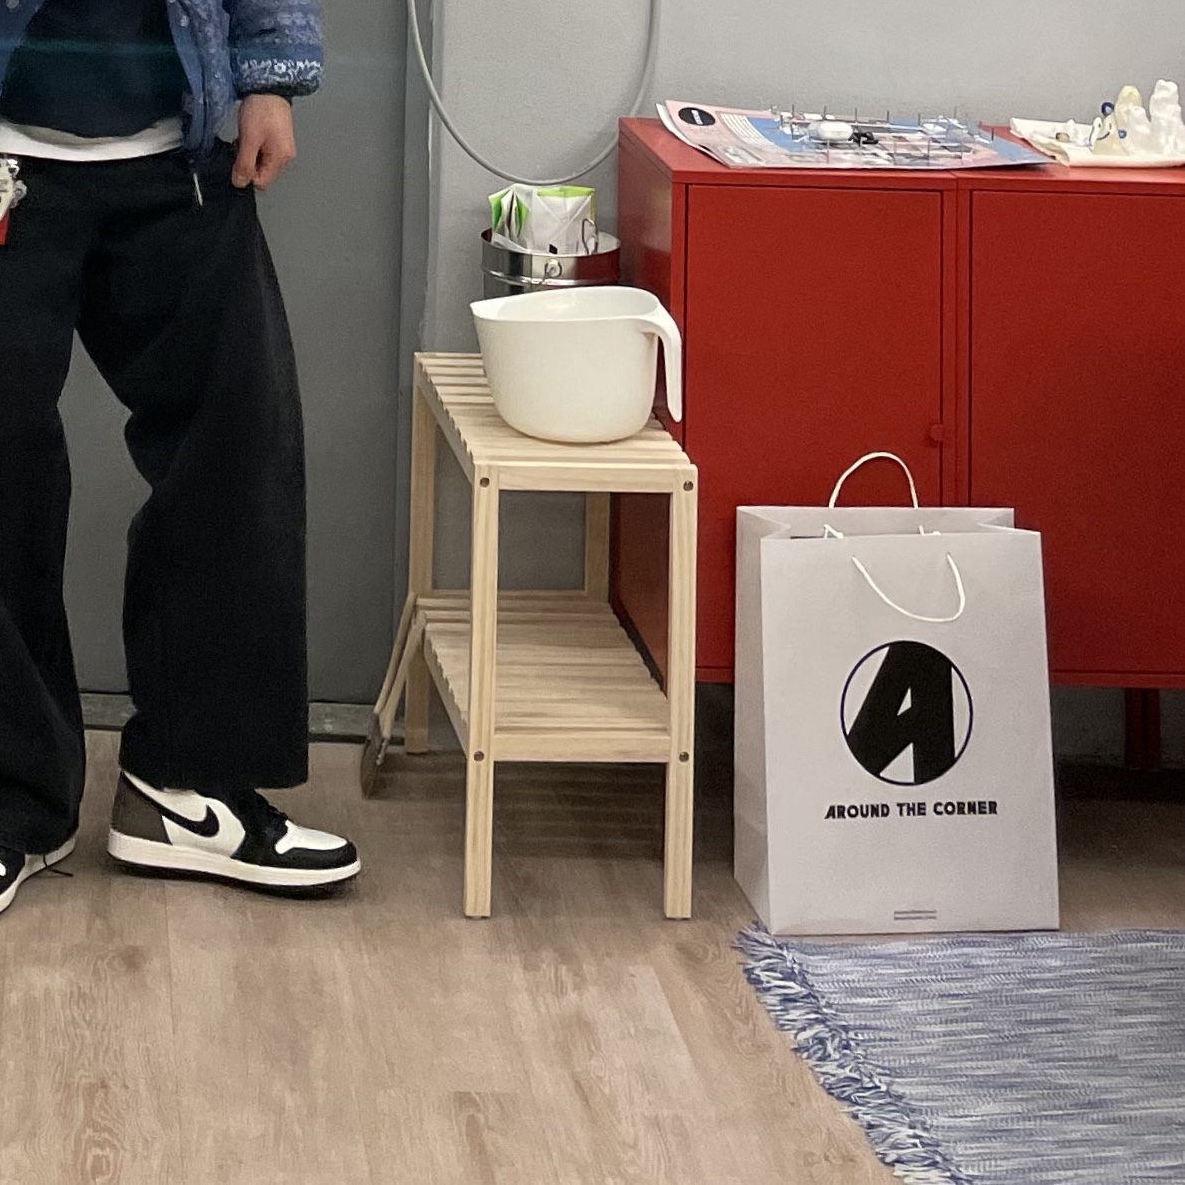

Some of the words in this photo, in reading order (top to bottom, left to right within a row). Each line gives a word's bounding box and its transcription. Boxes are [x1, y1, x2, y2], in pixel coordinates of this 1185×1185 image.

[824, 803, 890, 820] AROUND
[896, 801, 927, 817] THE
[933, 800, 998, 816] CORNER
